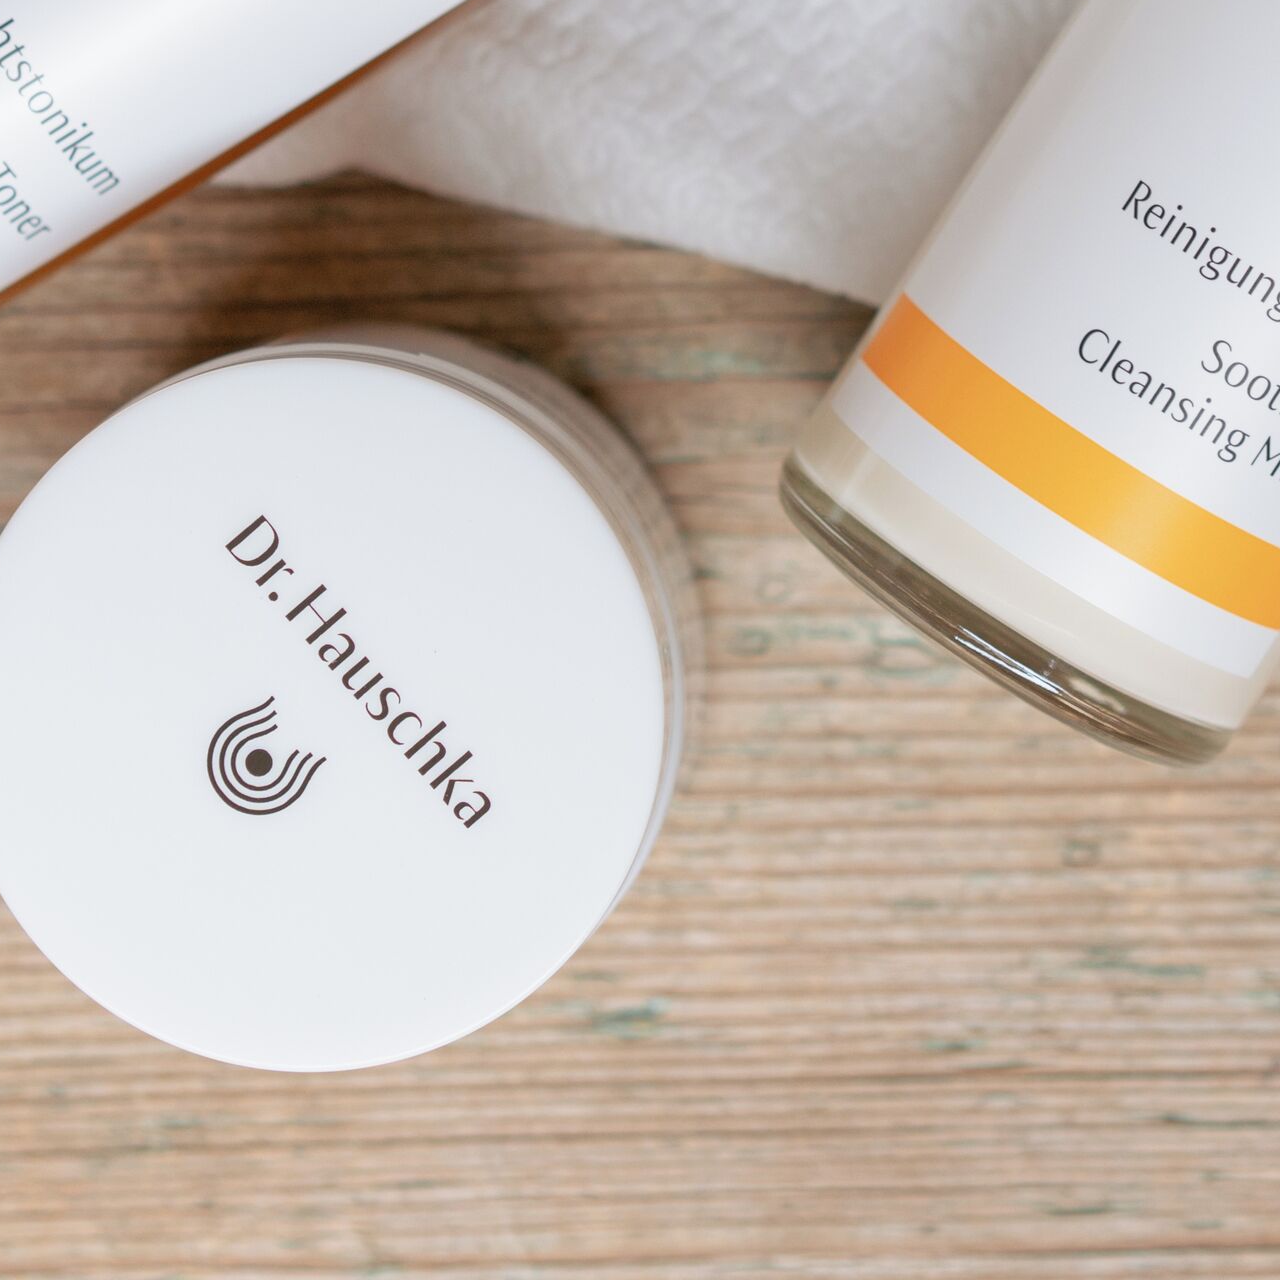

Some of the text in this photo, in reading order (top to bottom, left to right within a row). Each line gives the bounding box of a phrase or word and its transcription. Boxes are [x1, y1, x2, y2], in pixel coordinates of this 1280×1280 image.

[1077, 328, 1250, 463] Cleansing
[224, 514, 492, 830] Dr. Hauschka
